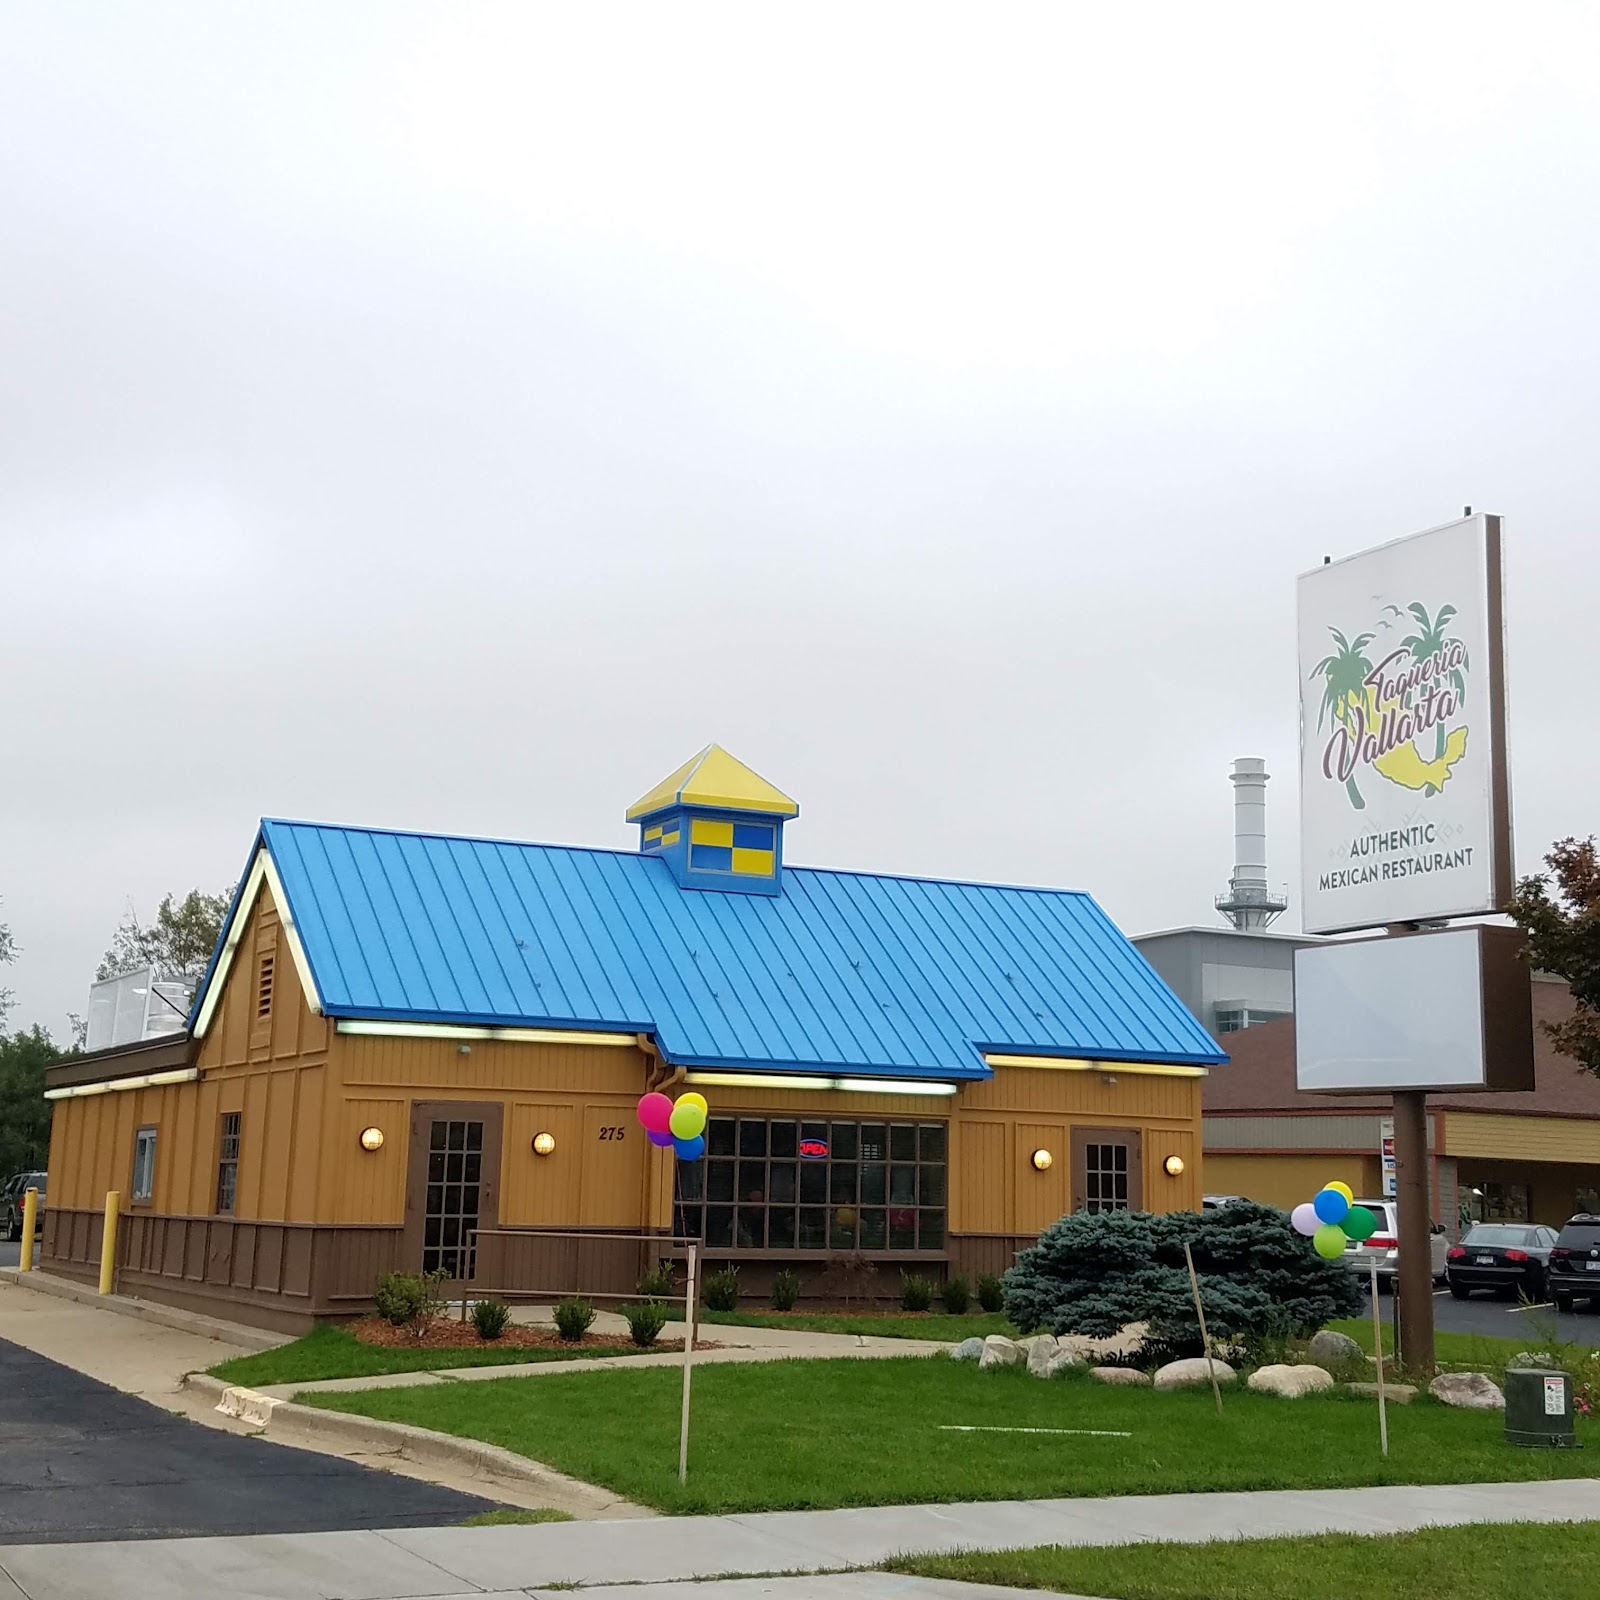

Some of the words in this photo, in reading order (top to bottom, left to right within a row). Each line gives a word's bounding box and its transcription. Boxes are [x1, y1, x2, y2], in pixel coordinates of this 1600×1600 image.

[1363, 640, 1467, 713] Taqueria
[1322, 685, 1459, 783] Vallarta
[1349, 823, 1436, 859] AUTHENTIC
[1318, 864, 1379, 891] MEXICAN
[1381, 847, 1474, 881] RESTAURANT
[598, 1126, 625, 1141] 275
